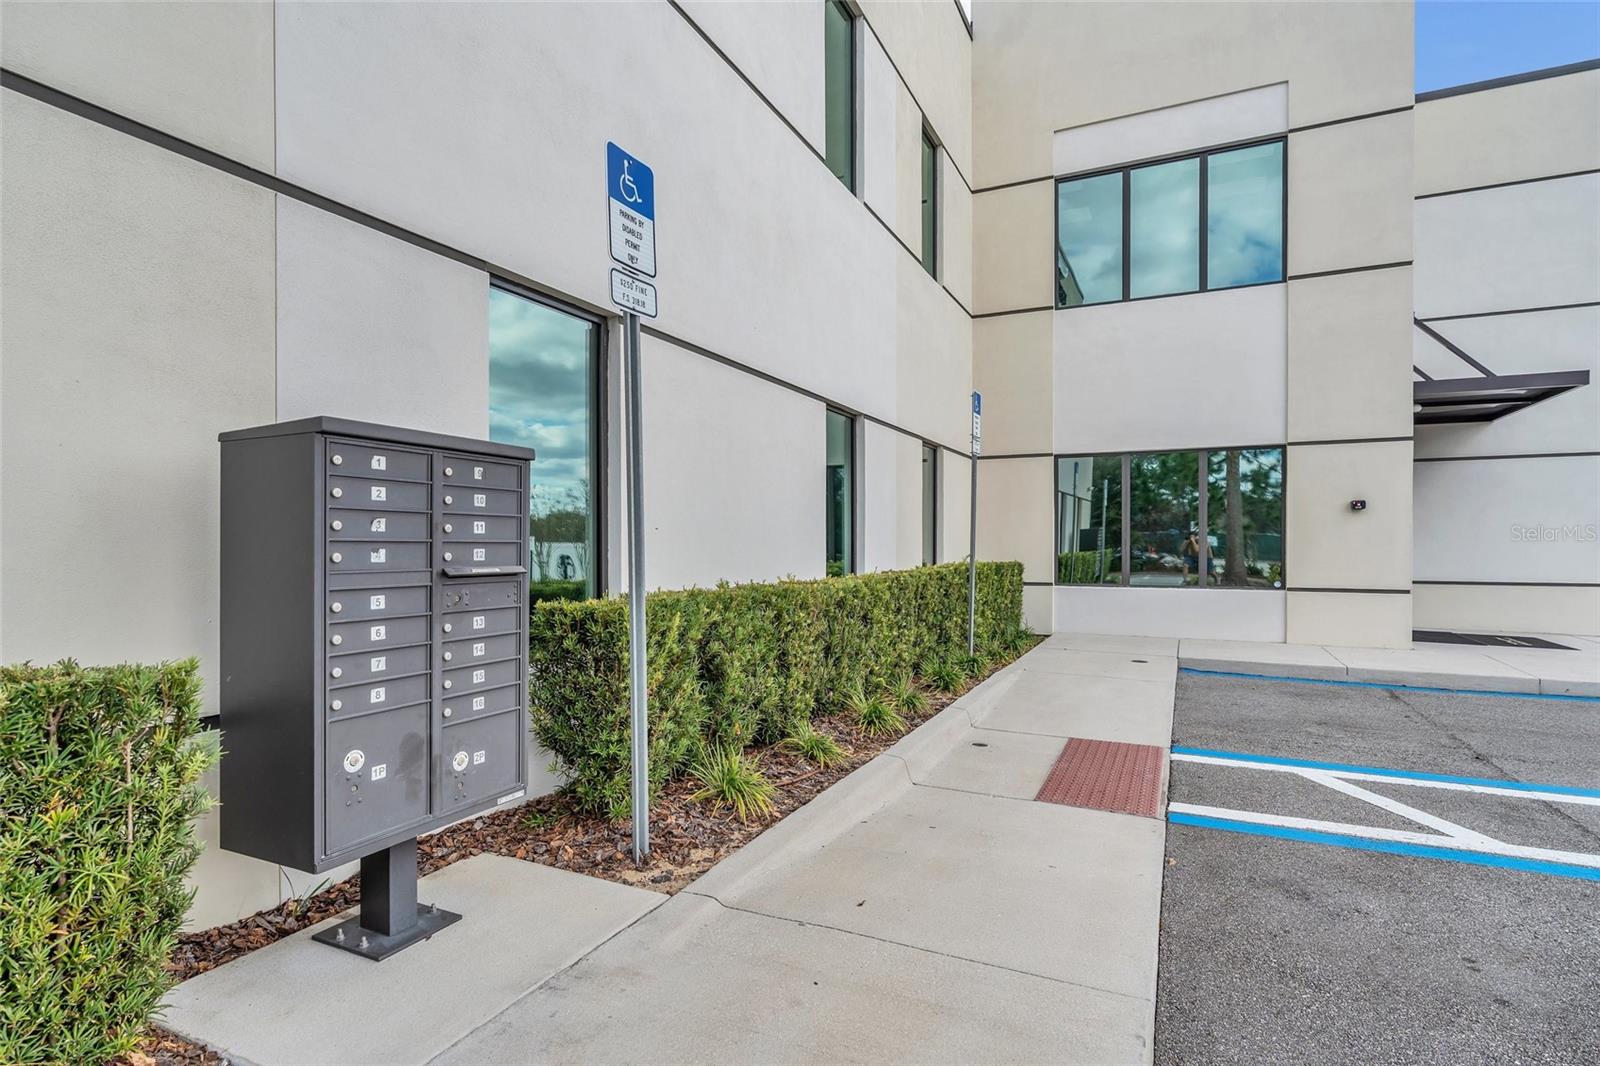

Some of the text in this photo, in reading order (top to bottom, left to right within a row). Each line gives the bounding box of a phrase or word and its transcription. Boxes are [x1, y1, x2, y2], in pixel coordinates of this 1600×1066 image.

[619, 208, 645, 229] PARKING BY
[622, 223, 643, 241] DISABLED
[625, 238, 641, 252] PERMIT
[620, 278, 648, 297] $250 FINE
[475, 495, 485, 506] 10
[475, 523, 485, 532] 11
[475, 550, 485, 559] 12
[475, 617, 484, 628] 13
[475, 644, 484, 654] 14
[475, 671, 484, 681] 15
[475, 699, 484, 709] 16
[474, 751, 485, 763] 2P
[373, 766, 385, 779] 1P
